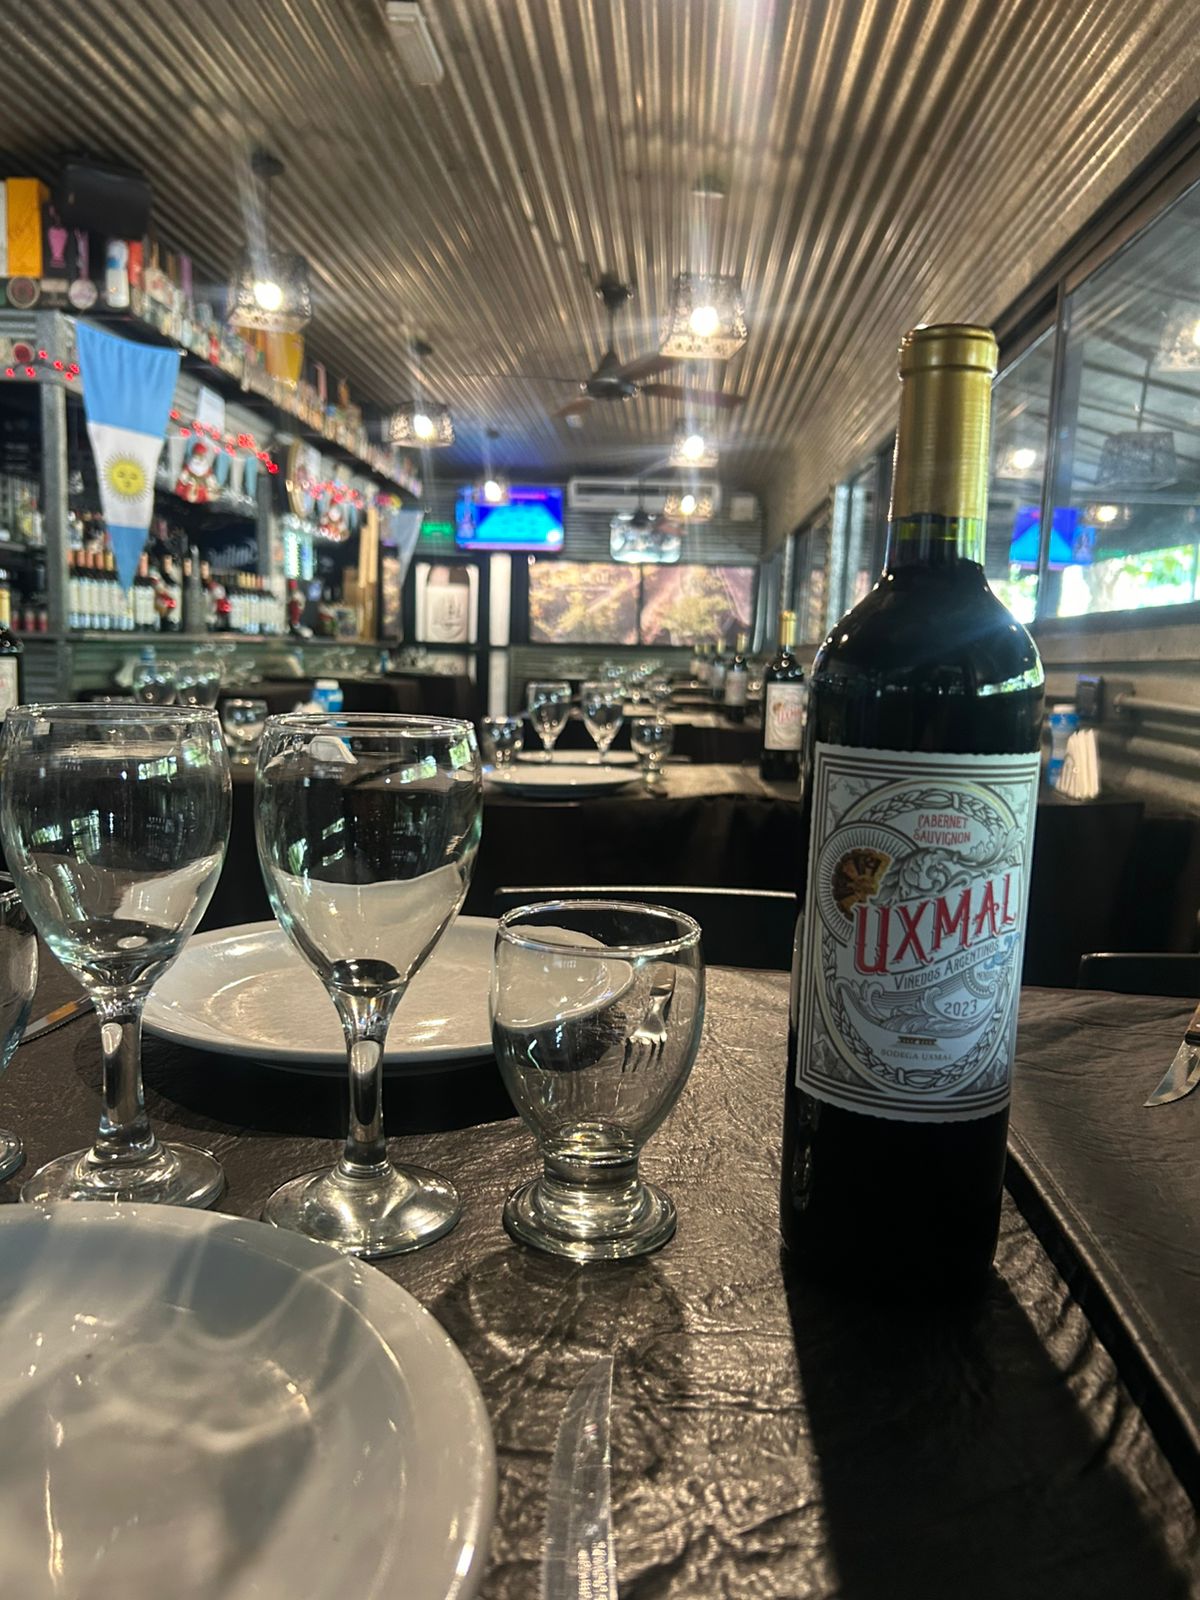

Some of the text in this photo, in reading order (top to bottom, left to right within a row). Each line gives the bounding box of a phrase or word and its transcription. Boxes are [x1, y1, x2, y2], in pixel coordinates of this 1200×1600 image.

[918, 814, 968, 829] CABERNET
[913, 829, 971, 845] SAUVIGNON
[855, 874, 1016, 974] UXMAL
[894, 940, 999, 990] VIÑEDOS ARGENTINOS
[944, 999, 977, 1017] 2023
